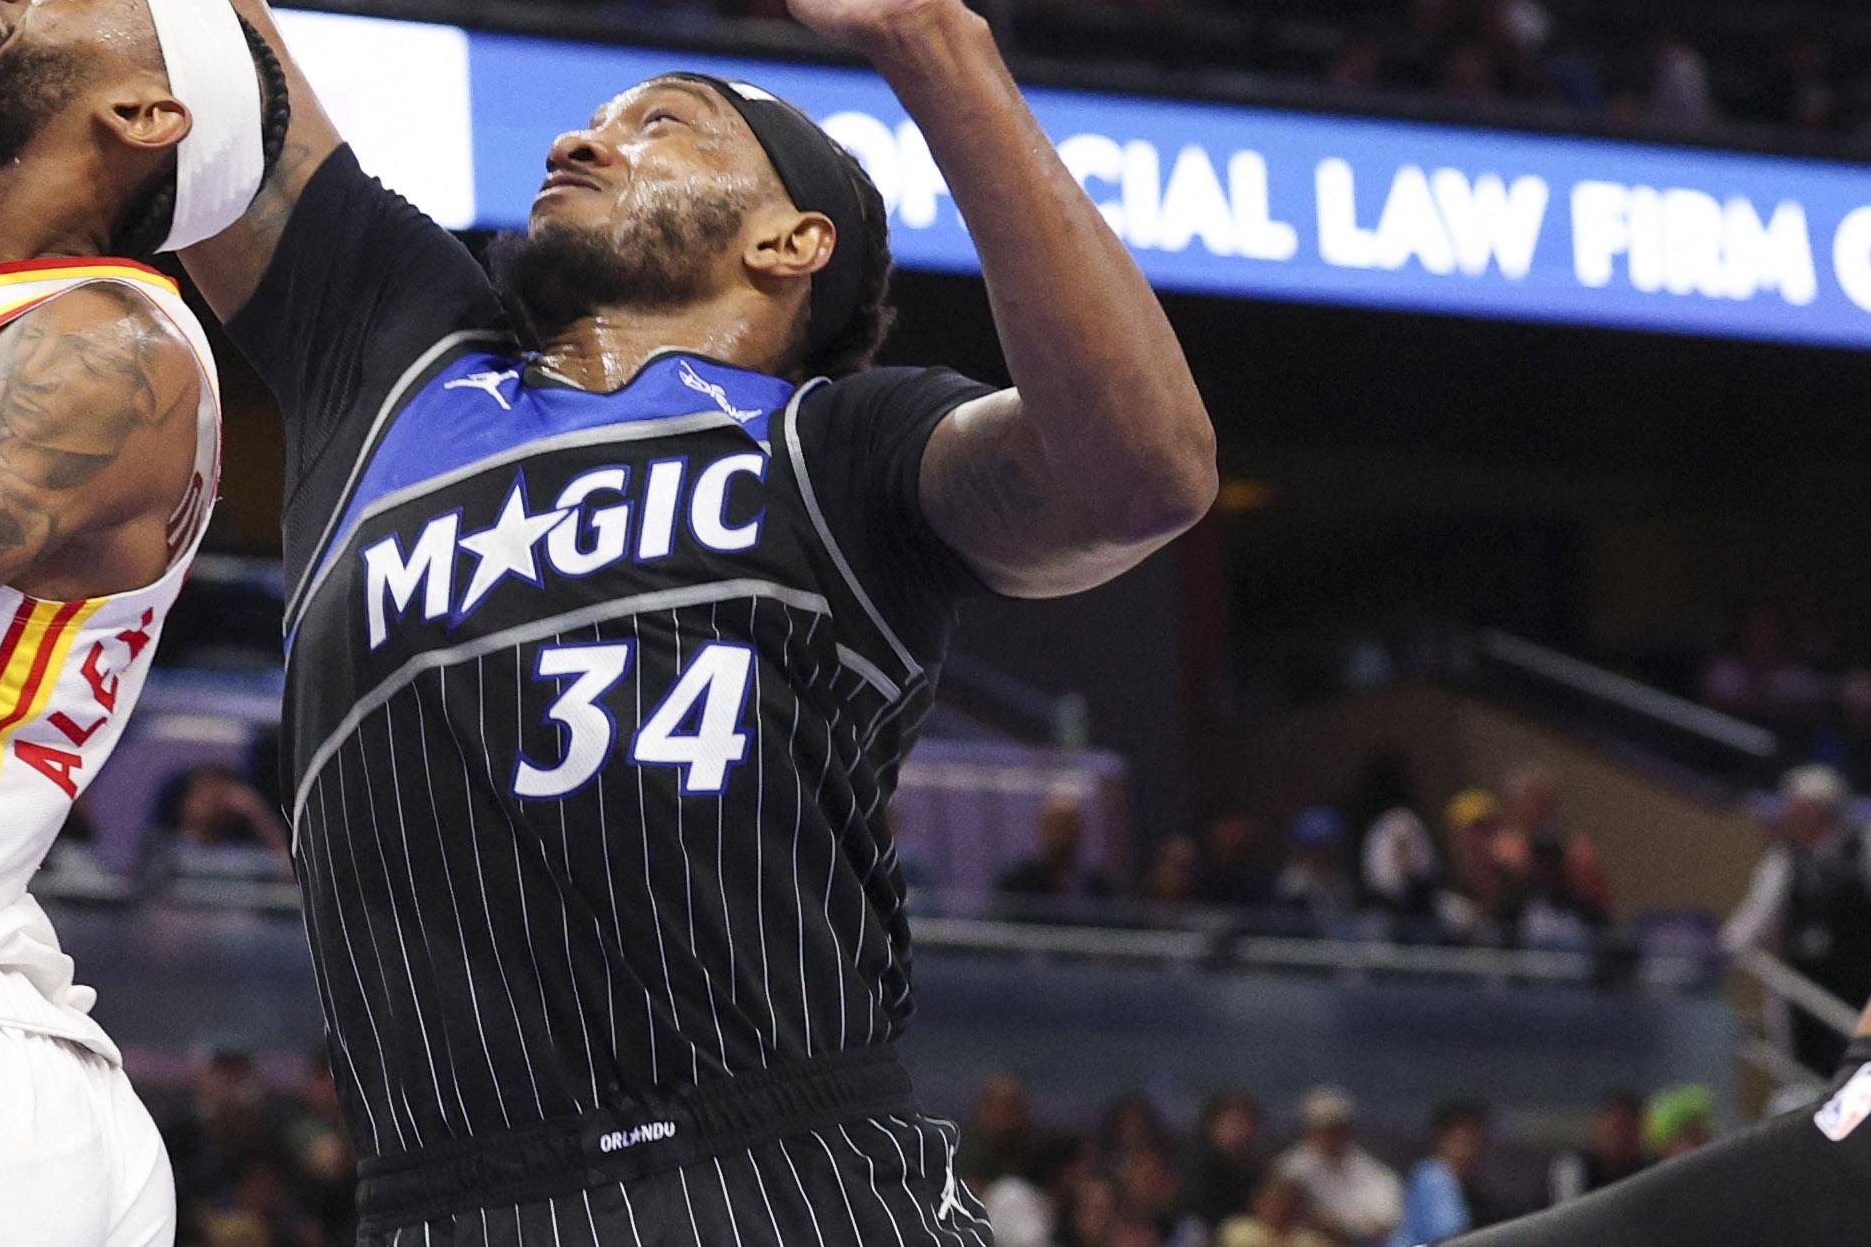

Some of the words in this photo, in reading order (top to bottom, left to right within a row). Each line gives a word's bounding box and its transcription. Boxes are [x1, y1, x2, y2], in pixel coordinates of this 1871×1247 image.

[1314, 156, 1550, 281] LAW
[1570, 180, 1818, 307] FIRM
[509, 639, 757, 798] 34
